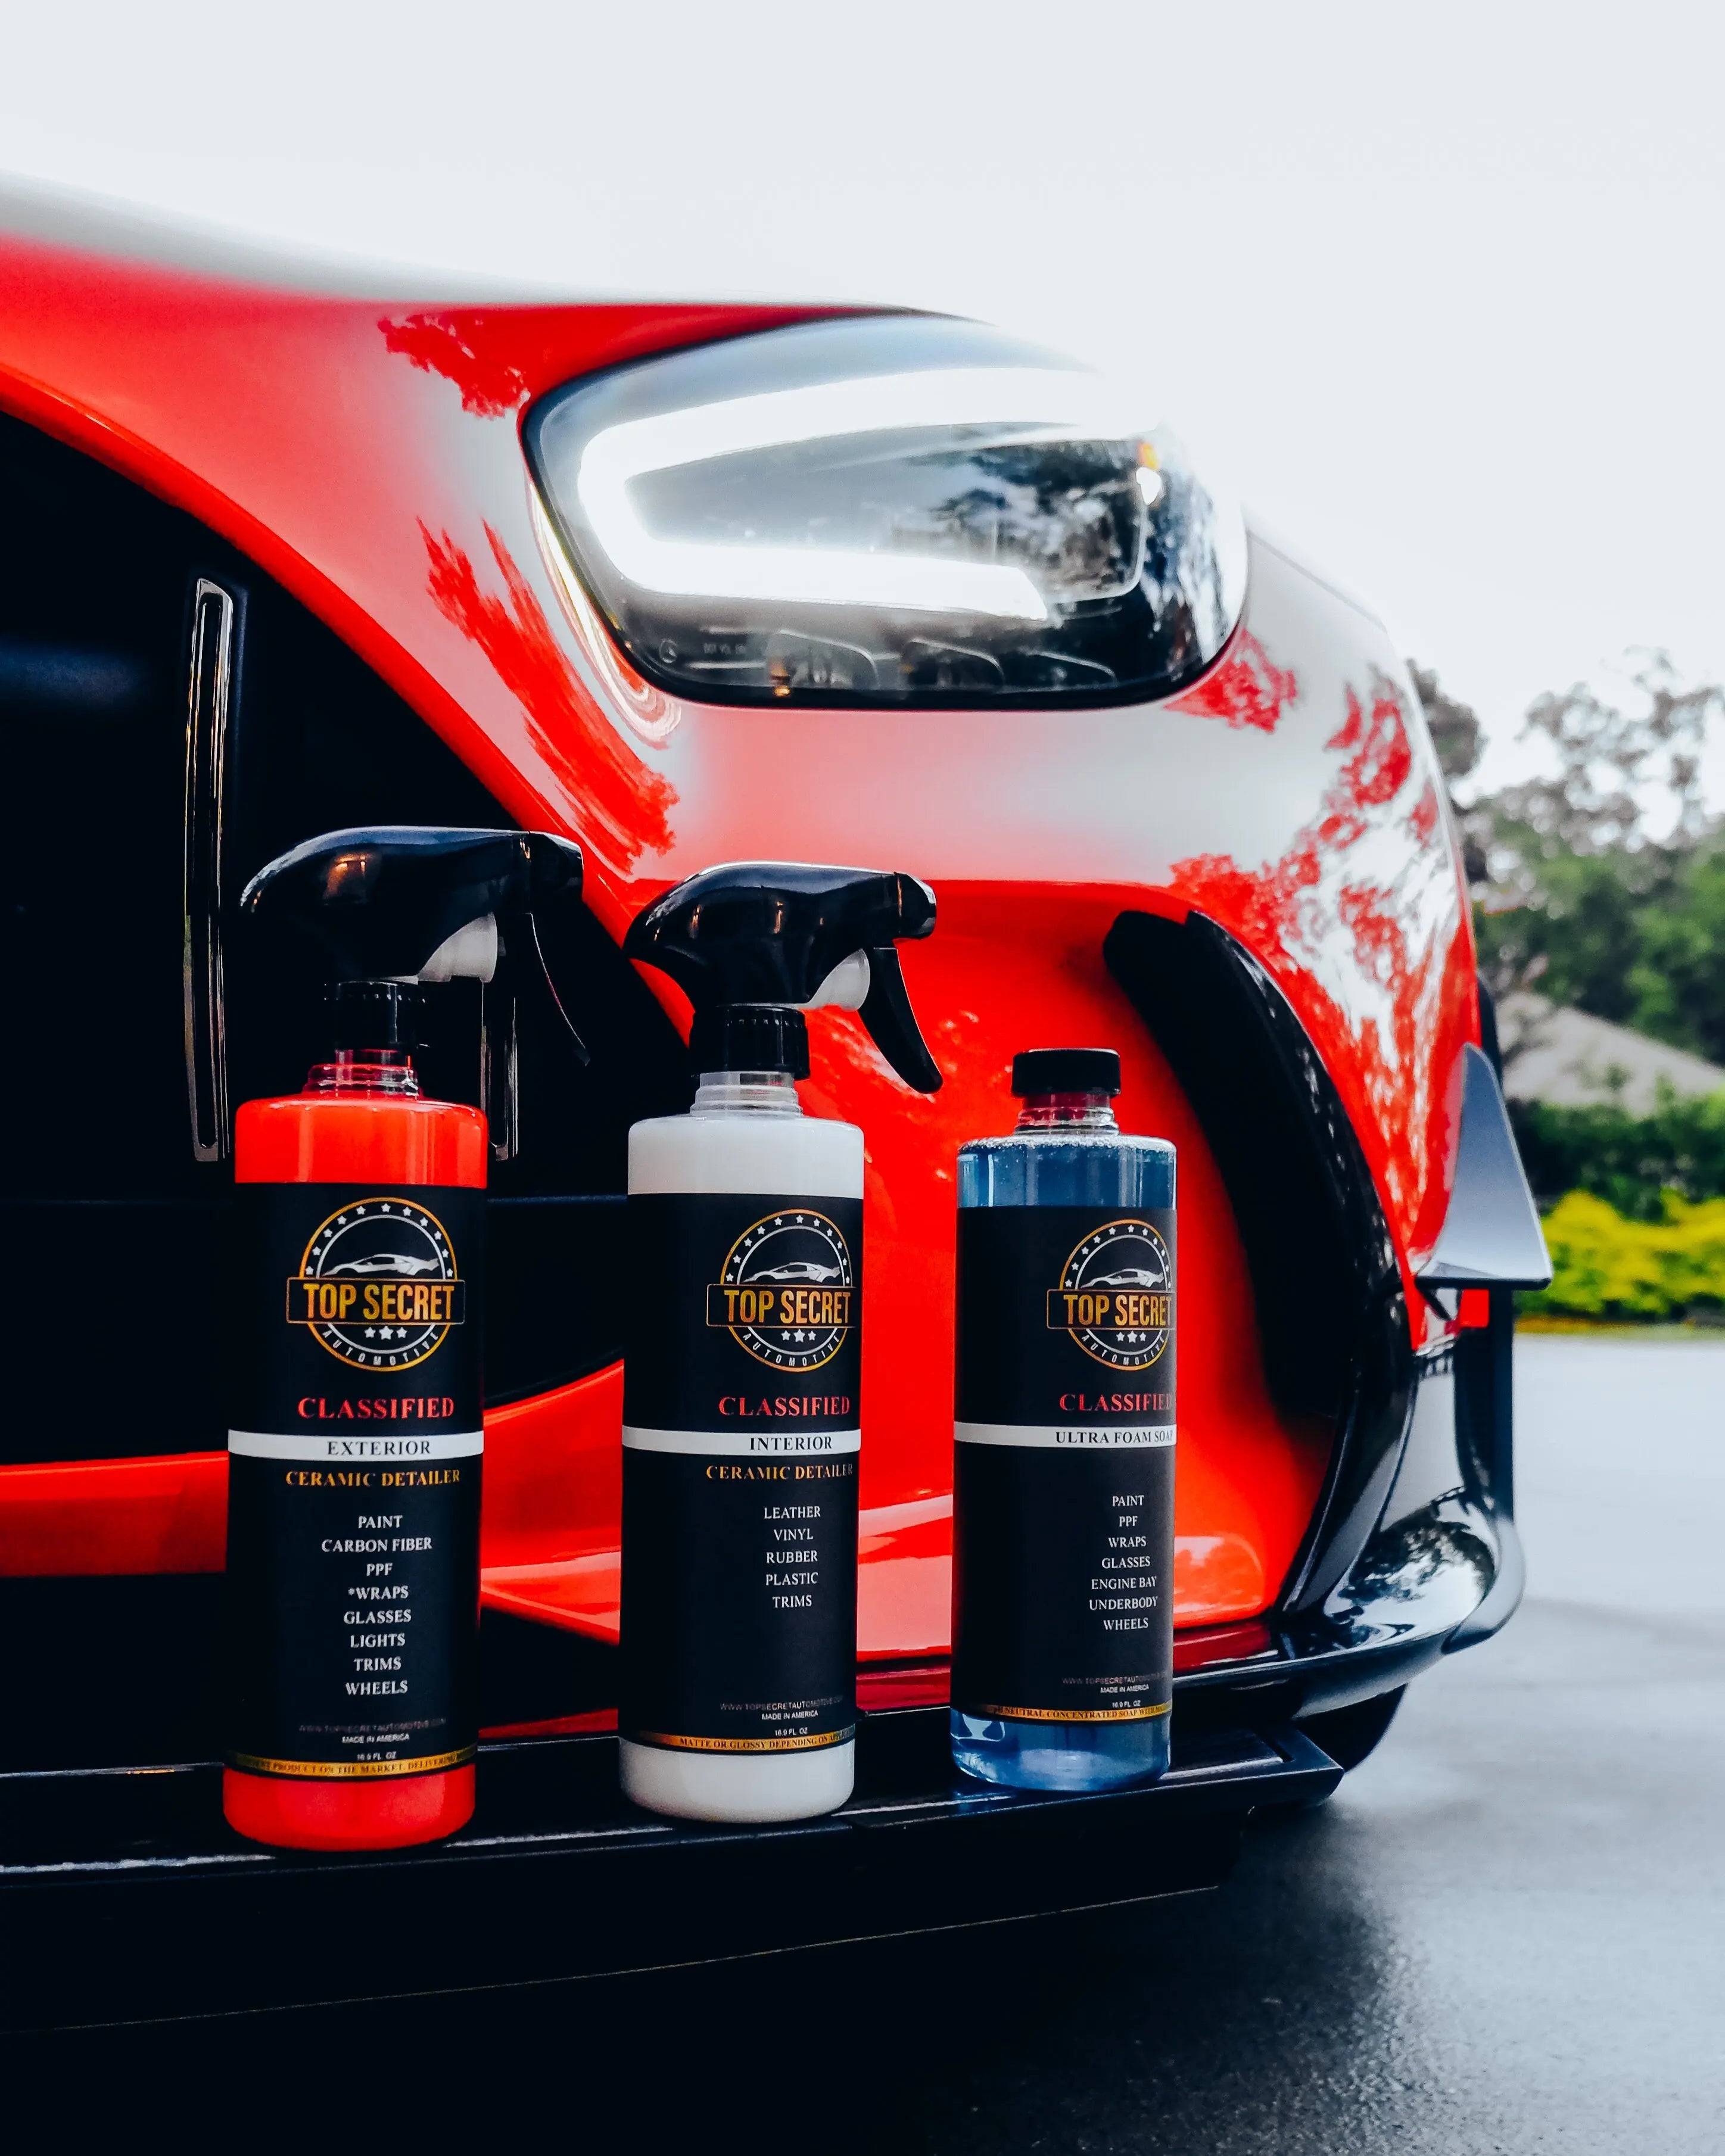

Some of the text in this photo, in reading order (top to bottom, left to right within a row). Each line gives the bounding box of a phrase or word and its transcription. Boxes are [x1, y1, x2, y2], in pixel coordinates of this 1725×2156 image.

[303, 1283, 455, 1320] TOP SECRET
[724, 1289, 851, 1324] TOP SECRET
[1063, 1294, 1172, 1326] TOP SECRET
[322, 1329, 440, 1366] AUTOMOTIVE
[743, 1332, 840, 1367] AUTOMOTIVE
[1082, 1334, 1165, 1366] AUTOMOTIVE
[298, 1397, 454, 1419] CLASSIFIED
[718, 1396, 850, 1416] CLASSIFIED
[749, 1436, 832, 1451] INTERIOR
[1055, 1430, 1173, 1444] ULTRA FOAM SOAP
[326, 1440, 431, 1456] EXTERIOR
[285, 1469, 460, 1487] CERAMIC DETAILER
[706, 1463, 853, 1480] CERAMIC DETAILER
[1112, 1495, 1144, 1507] PAINT
[764, 1506, 821, 1519] LEATHER
[357, 1515, 403, 1529] PAINT
[1119, 1516, 1138, 1527] PPF
[774, 1528, 814, 1541] VINYL
[1108, 1536, 1147, 1548] WRAPS
[321, 1537, 432, 1553] CARBON FIBER
[766, 1550, 818, 1564] RUBBER
[1101, 1556, 1150, 1569] GLASSES
[366, 1563, 393, 1577] PPF
[765, 1572, 818, 1586] PLASTIC
[1091, 1576, 1157, 1590] ENGINE BAY
[772, 1594, 812, 1609] TRIMS
[1089, 1596, 1158, 1610] UNDERBODY
[343, 1609, 412, 1625] GLASSES
[1103, 1618, 1148, 1631] WHEELS
[350, 1633, 406, 1648] LIGHTS
[353, 1657, 402, 1672] TRIMS
[345, 1680, 409, 1696] WHEELS
[791, 1710, 818, 1719] AMERICA
[1006, 1707, 1042, 1717] NEUTRAL
[1047, 1709, 1117, 1719] CONCENTRATED
[341, 1736, 365, 1744] MADE
[376, 1733, 410, 1743] AMERICA
[680, 1734, 829, 1749] MATTE OR GLOSSY DEPENDING ON
